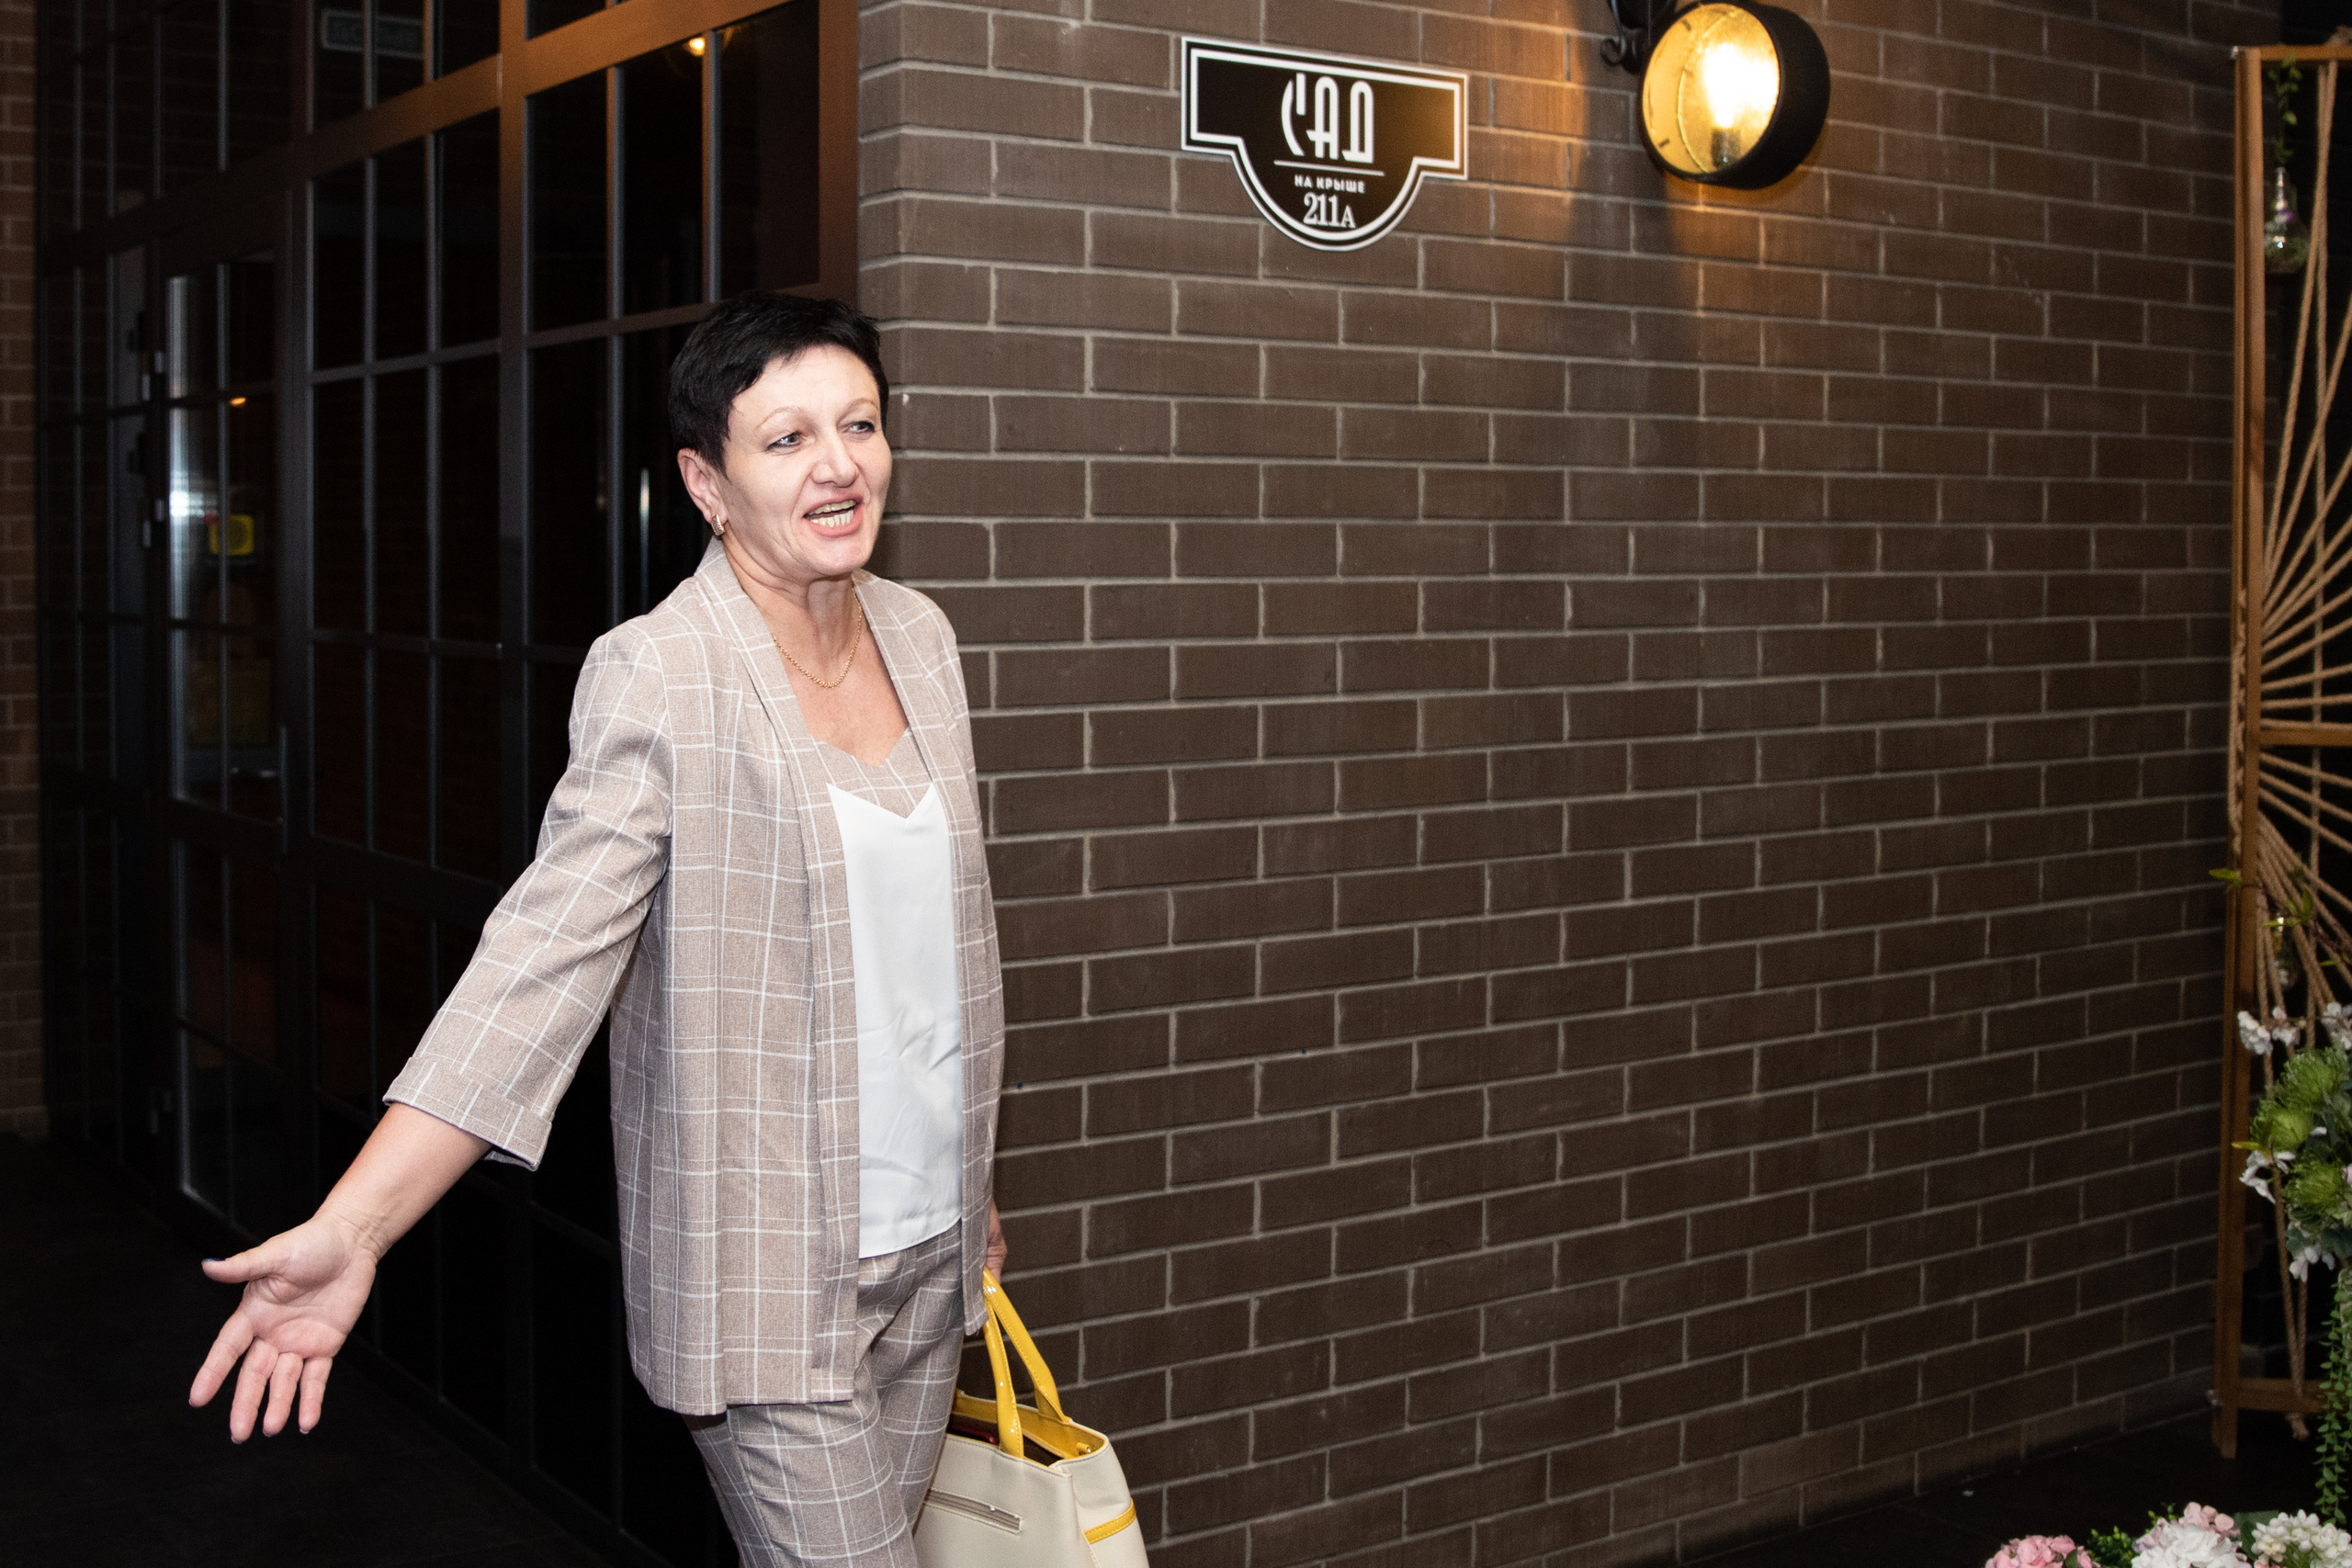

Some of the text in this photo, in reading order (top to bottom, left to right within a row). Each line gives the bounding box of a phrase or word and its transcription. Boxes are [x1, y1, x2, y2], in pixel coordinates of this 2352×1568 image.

[1281, 73, 1374, 164] САД
[1295, 174, 1365, 194] НА КРЫШЕ
